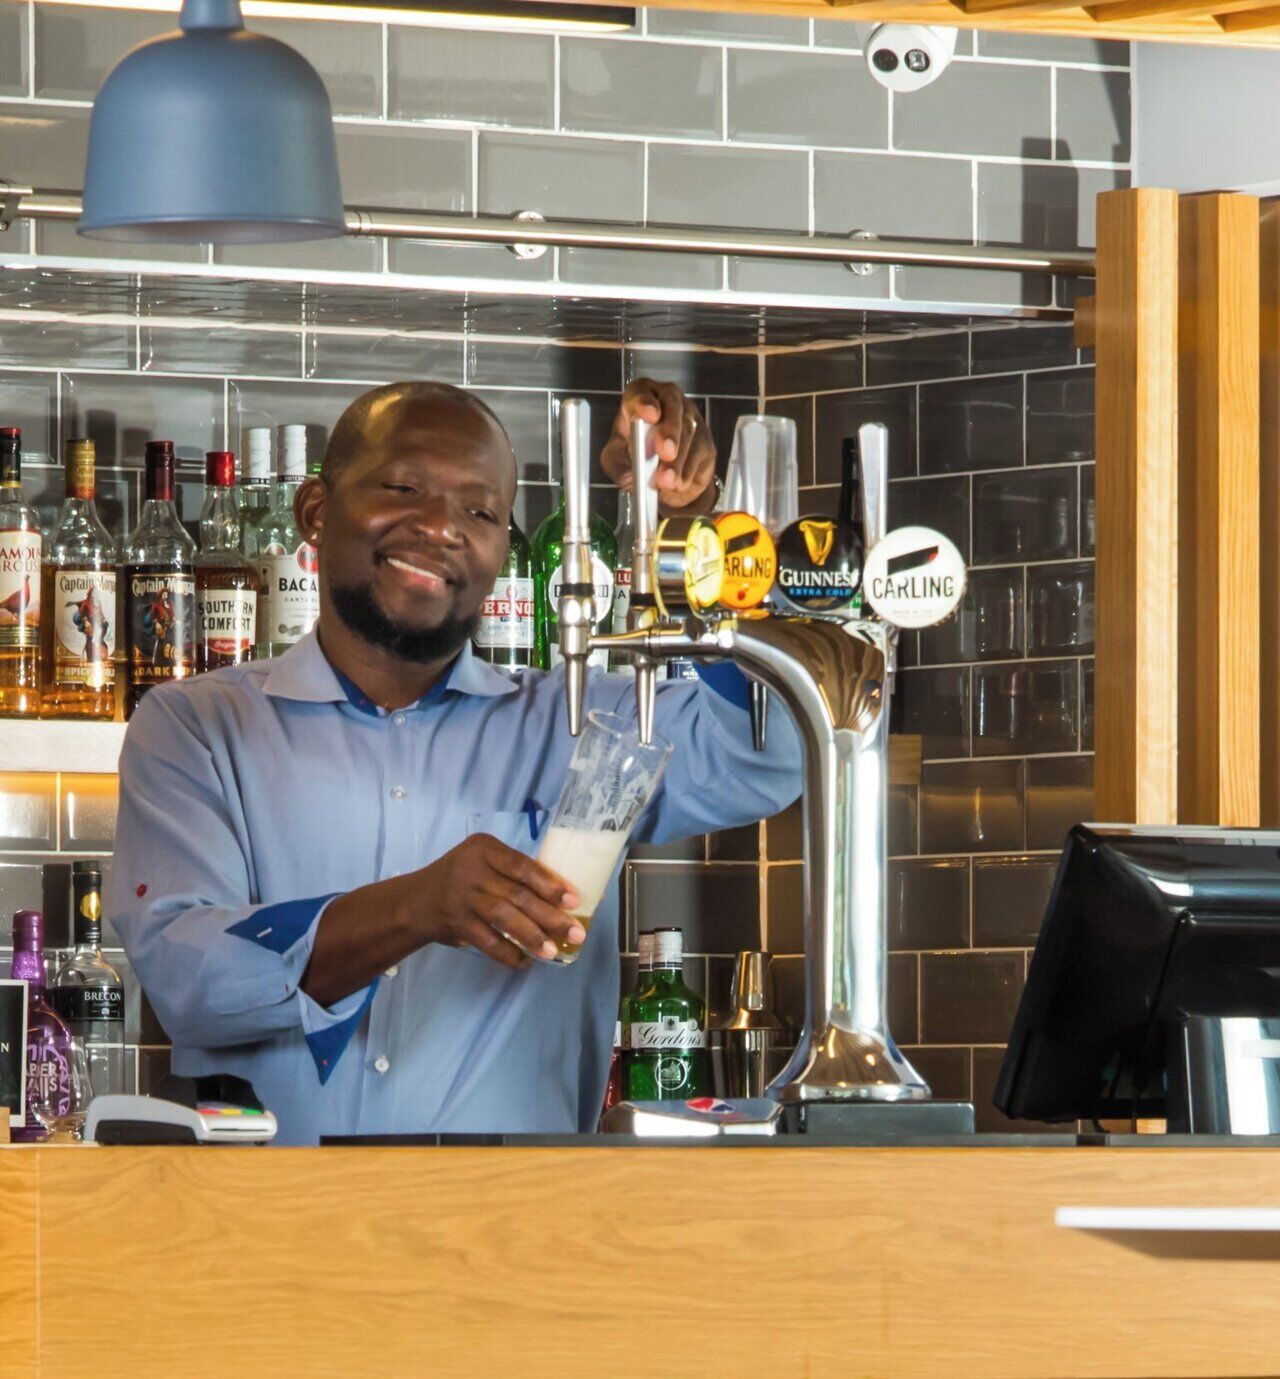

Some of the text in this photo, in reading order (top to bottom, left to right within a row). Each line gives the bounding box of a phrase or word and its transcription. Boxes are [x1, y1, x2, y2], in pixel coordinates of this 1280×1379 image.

[724, 556, 772, 579] ARLING
[60, 576, 95, 594] Captain
[132, 577, 164, 598] Captain
[279, 577, 319, 592] BACA
[789, 587, 852, 596] EXTRA COLD
[873, 576, 954, 599] CARLING
[198, 600, 254, 616] SOUTHRN
[483, 602, 535, 615] ERNO
[138, 665, 171, 676] DARK
[84, 991, 122, 1001] BRECON
[638, 1026, 702, 1046] Gordon's
